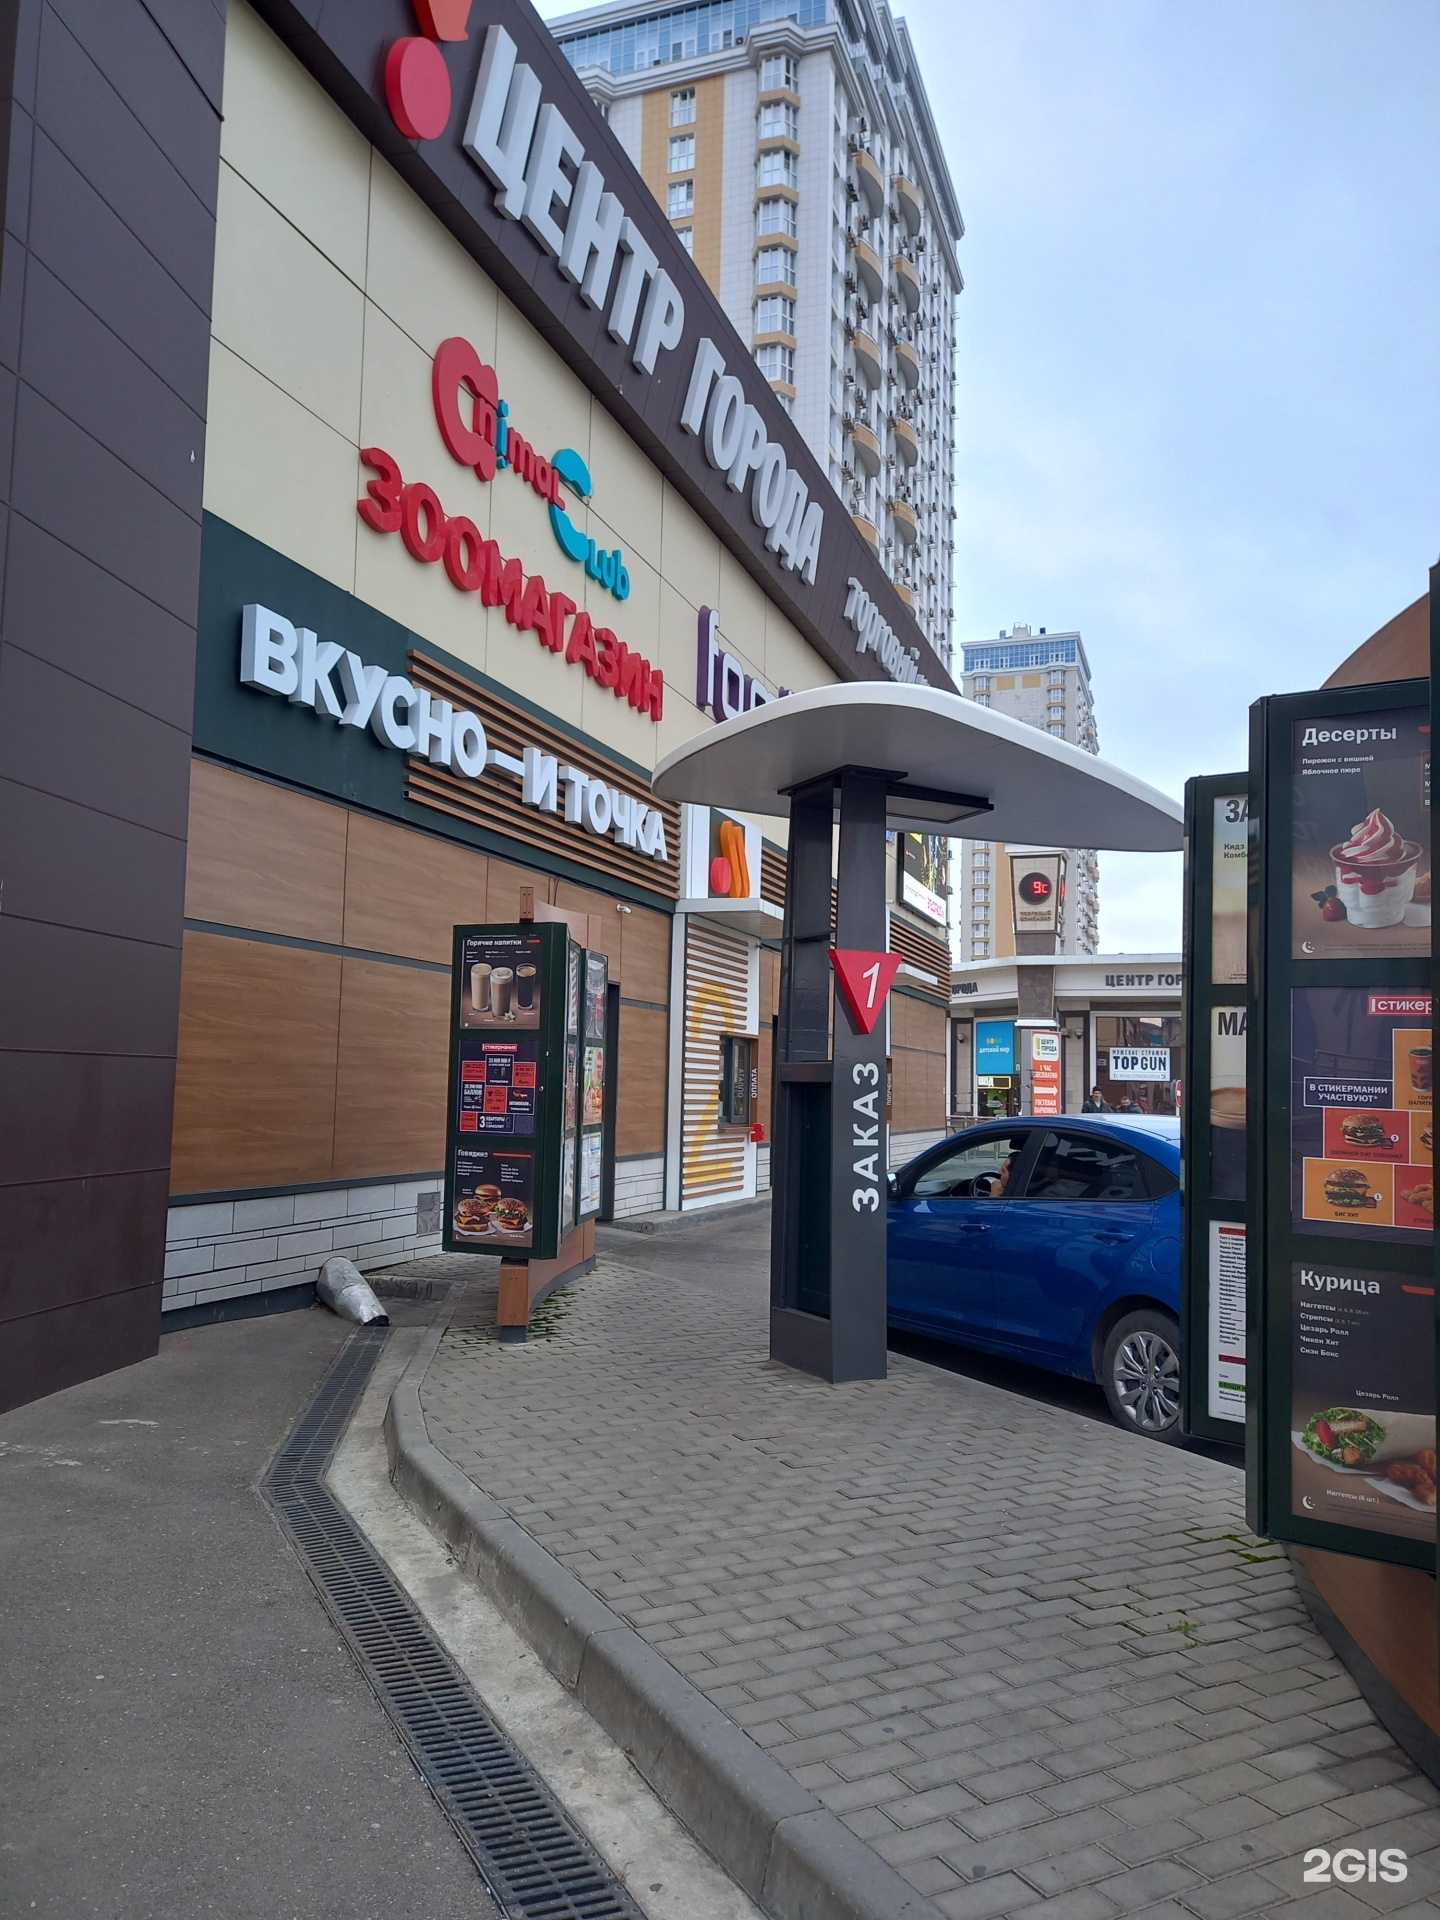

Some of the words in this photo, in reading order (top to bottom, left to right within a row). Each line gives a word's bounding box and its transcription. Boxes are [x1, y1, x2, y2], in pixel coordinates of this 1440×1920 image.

[463, 25, 685, 375] ЦЕНТР
[681, 338, 824, 586] ГОРОДА
[357, 448, 664, 722] ЗООМАГАЗИН
[1302, 728, 1397, 746] Десерты
[558, 765, 668, 862] ТОЧКА
[863, 961, 881, 1009] 1
[1105, 974, 1153, 988] ЦЕНТР
[1317, 1084, 1388, 1094] СТИКЕРМАНИИ
[853, 1063, 879, 1212] ЗАКАЗ
[1301, 1270, 1381, 1295] Курица
[1300, 1301, 1336, 1311] Наггетсы
[1300, 1324, 1329, 1333] Цезарь
[1330, 1327, 1349, 1336] Ролл
